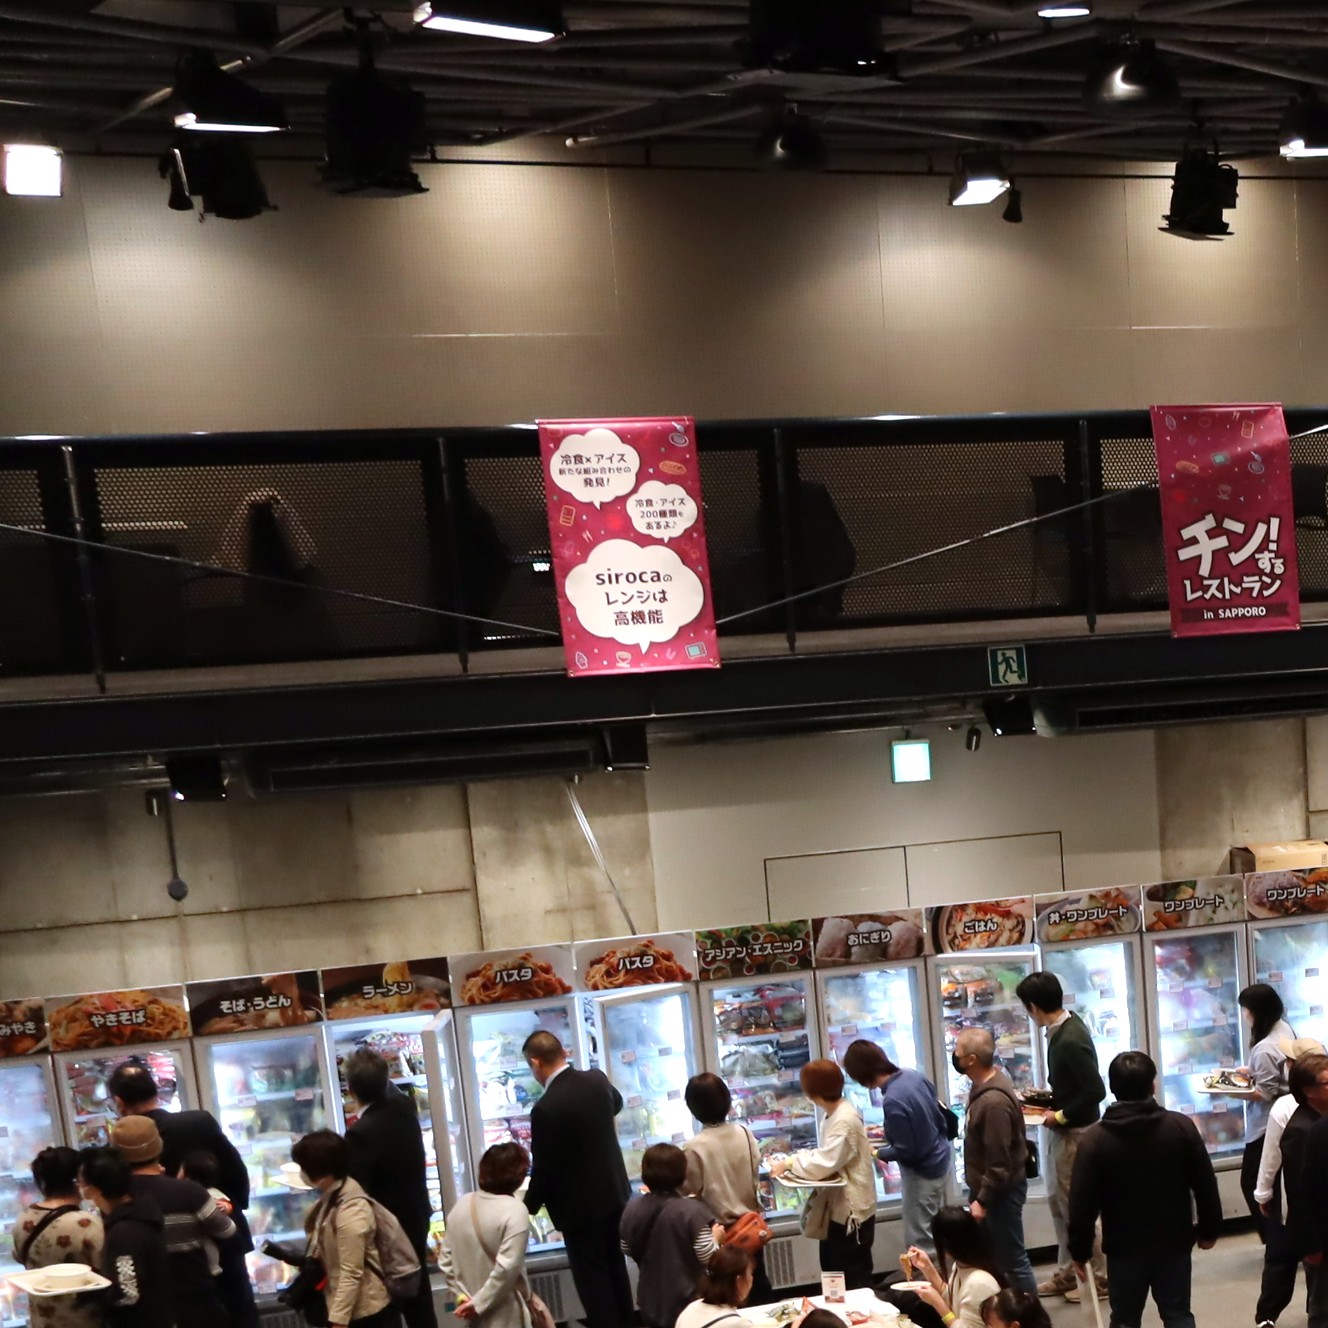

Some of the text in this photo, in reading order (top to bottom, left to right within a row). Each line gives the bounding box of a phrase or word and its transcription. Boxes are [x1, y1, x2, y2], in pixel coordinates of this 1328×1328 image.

[583, 477, 610, 488] 発見!
[1177, 513, 1280, 577] チン!
[1254, 550, 1285, 574] する
[595, 568, 673, 585] sirocaの
[1184, 575, 1281, 601] レストラン
[605, 590, 668, 606] レンジは
[613, 609, 664, 626] 高機能
[1203, 606, 1267, 619] in SAPPORO
[1266, 886, 1325, 902] ワンプレート
[1164, 894, 1225, 913] ワンプレート
[964, 918, 998, 934] ごはん
[847, 929, 893, 947] おにぎり
[704, 939, 804, 962] アジアン・エスニック
[617, 954, 655, 971] パスタ
[495, 967, 533, 985] パスタ
[362, 982, 414, 999] ラーメン
[219, 995, 292, 1014] そば・うどん
[90, 1010, 147, 1029] やきそば
